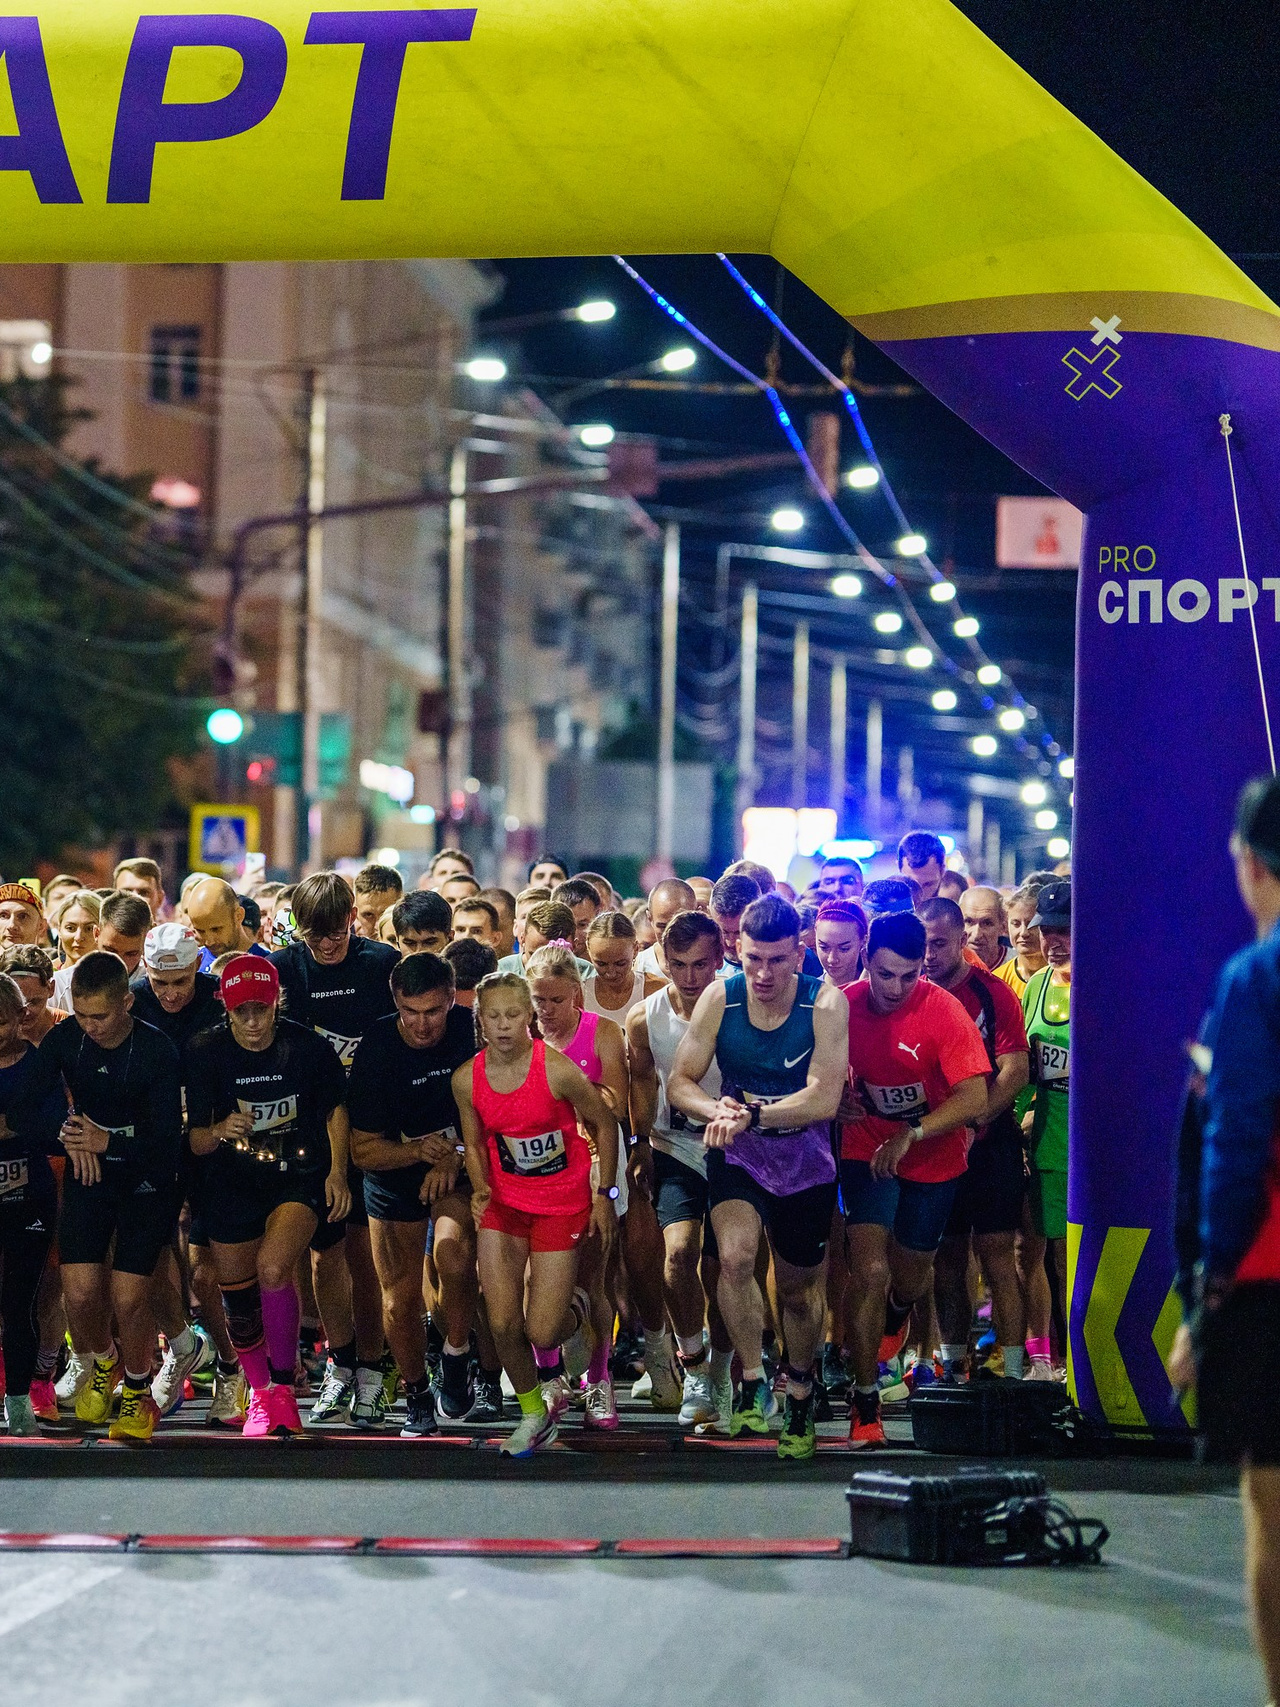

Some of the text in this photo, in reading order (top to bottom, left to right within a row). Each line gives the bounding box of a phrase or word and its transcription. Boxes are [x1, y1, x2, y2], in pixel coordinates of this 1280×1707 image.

[1099, 545, 1156, 573] PRO
[225, 972, 271, 988] RUS SIA
[311, 988, 355, 998] appzone.co
[1042, 1045, 1068, 1070] 527
[235, 1074, 283, 1085] appzone.co
[879, 1086, 918, 1103] 139
[251, 1100, 290, 1120] 570
[519, 1134, 558, 1157] 194
